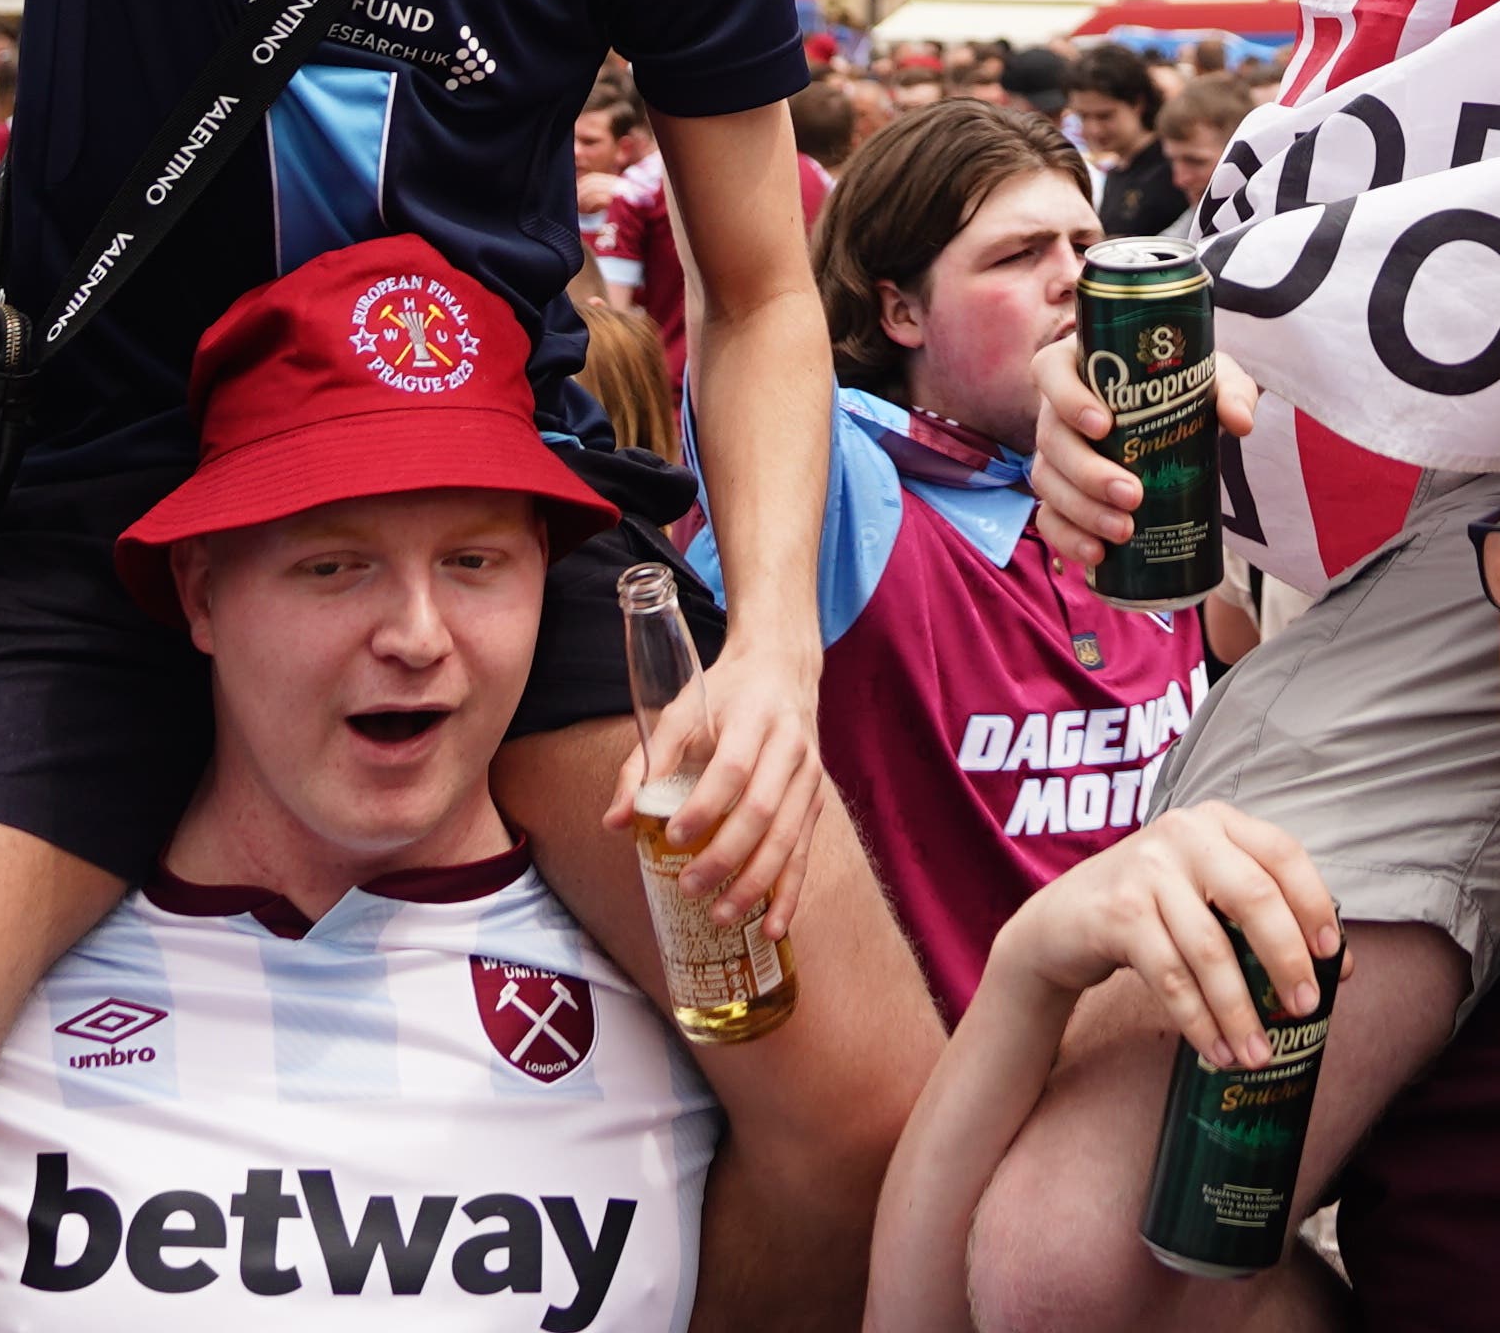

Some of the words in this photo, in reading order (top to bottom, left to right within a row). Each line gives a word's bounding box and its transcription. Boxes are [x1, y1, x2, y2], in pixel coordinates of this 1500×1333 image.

[419, 48, 452, 68] UK
[145, 94, 241, 206] VALENTINO
[46, 232, 135, 343] VALENTINO
[351, 274, 425, 326] EUROPEAN
[426, 278, 470, 326] FINAL
[403, 296, 416, 311] H
[383, 328, 399, 341] W
[436, 329, 449, 343] U
[366, 355, 446, 394] PRAGUE
[444, 359, 474, 390] 2023
[69, 1045, 157, 1070] umbro
[525, 1059, 569, 1075] LONDON
[19, 1151, 639, 1331] betway
